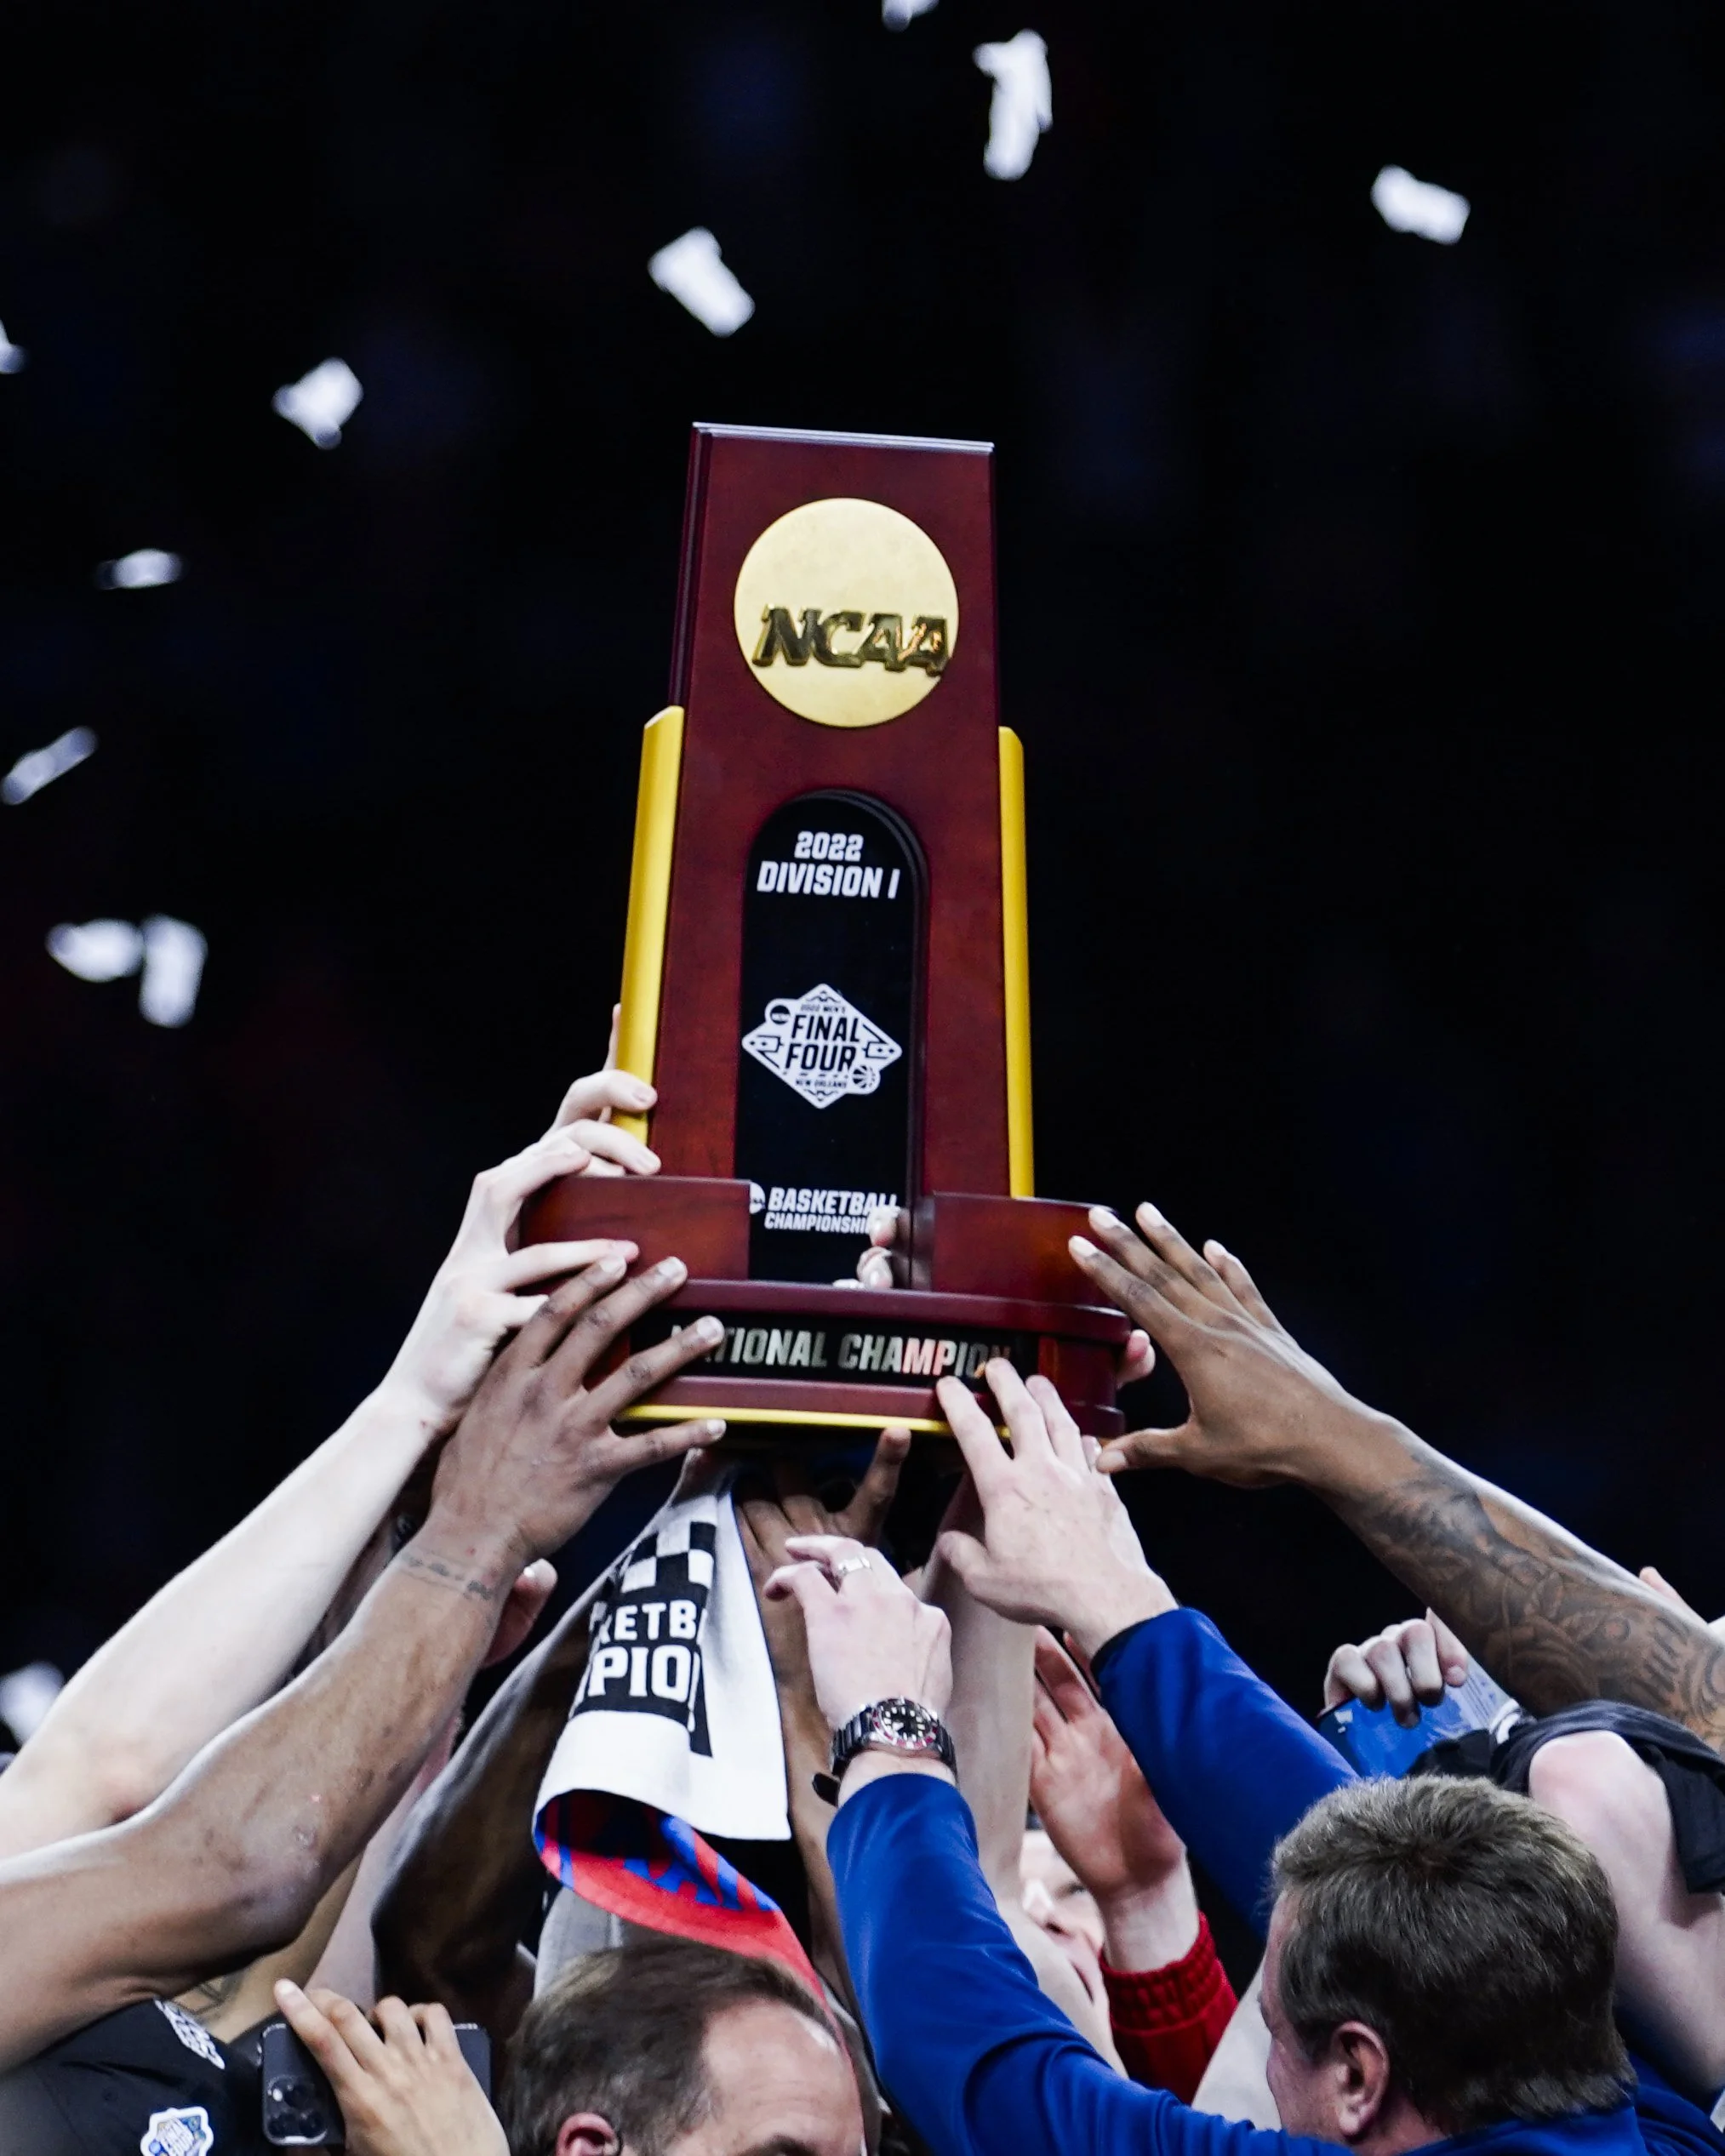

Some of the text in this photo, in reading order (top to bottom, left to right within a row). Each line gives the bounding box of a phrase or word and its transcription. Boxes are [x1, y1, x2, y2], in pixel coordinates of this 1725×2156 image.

[752, 604, 948, 677] NCAA
[794, 830, 864, 861] 2022
[757, 860, 901, 899] DIVISION I
[791, 1014, 860, 1042] FINAL
[785, 1043, 857, 1072] FOUR
[764, 1212, 871, 1235] CHAMPIONSHI
[671, 1325, 828, 1367] TIONAL
[579, 1642, 701, 1707] PIO
